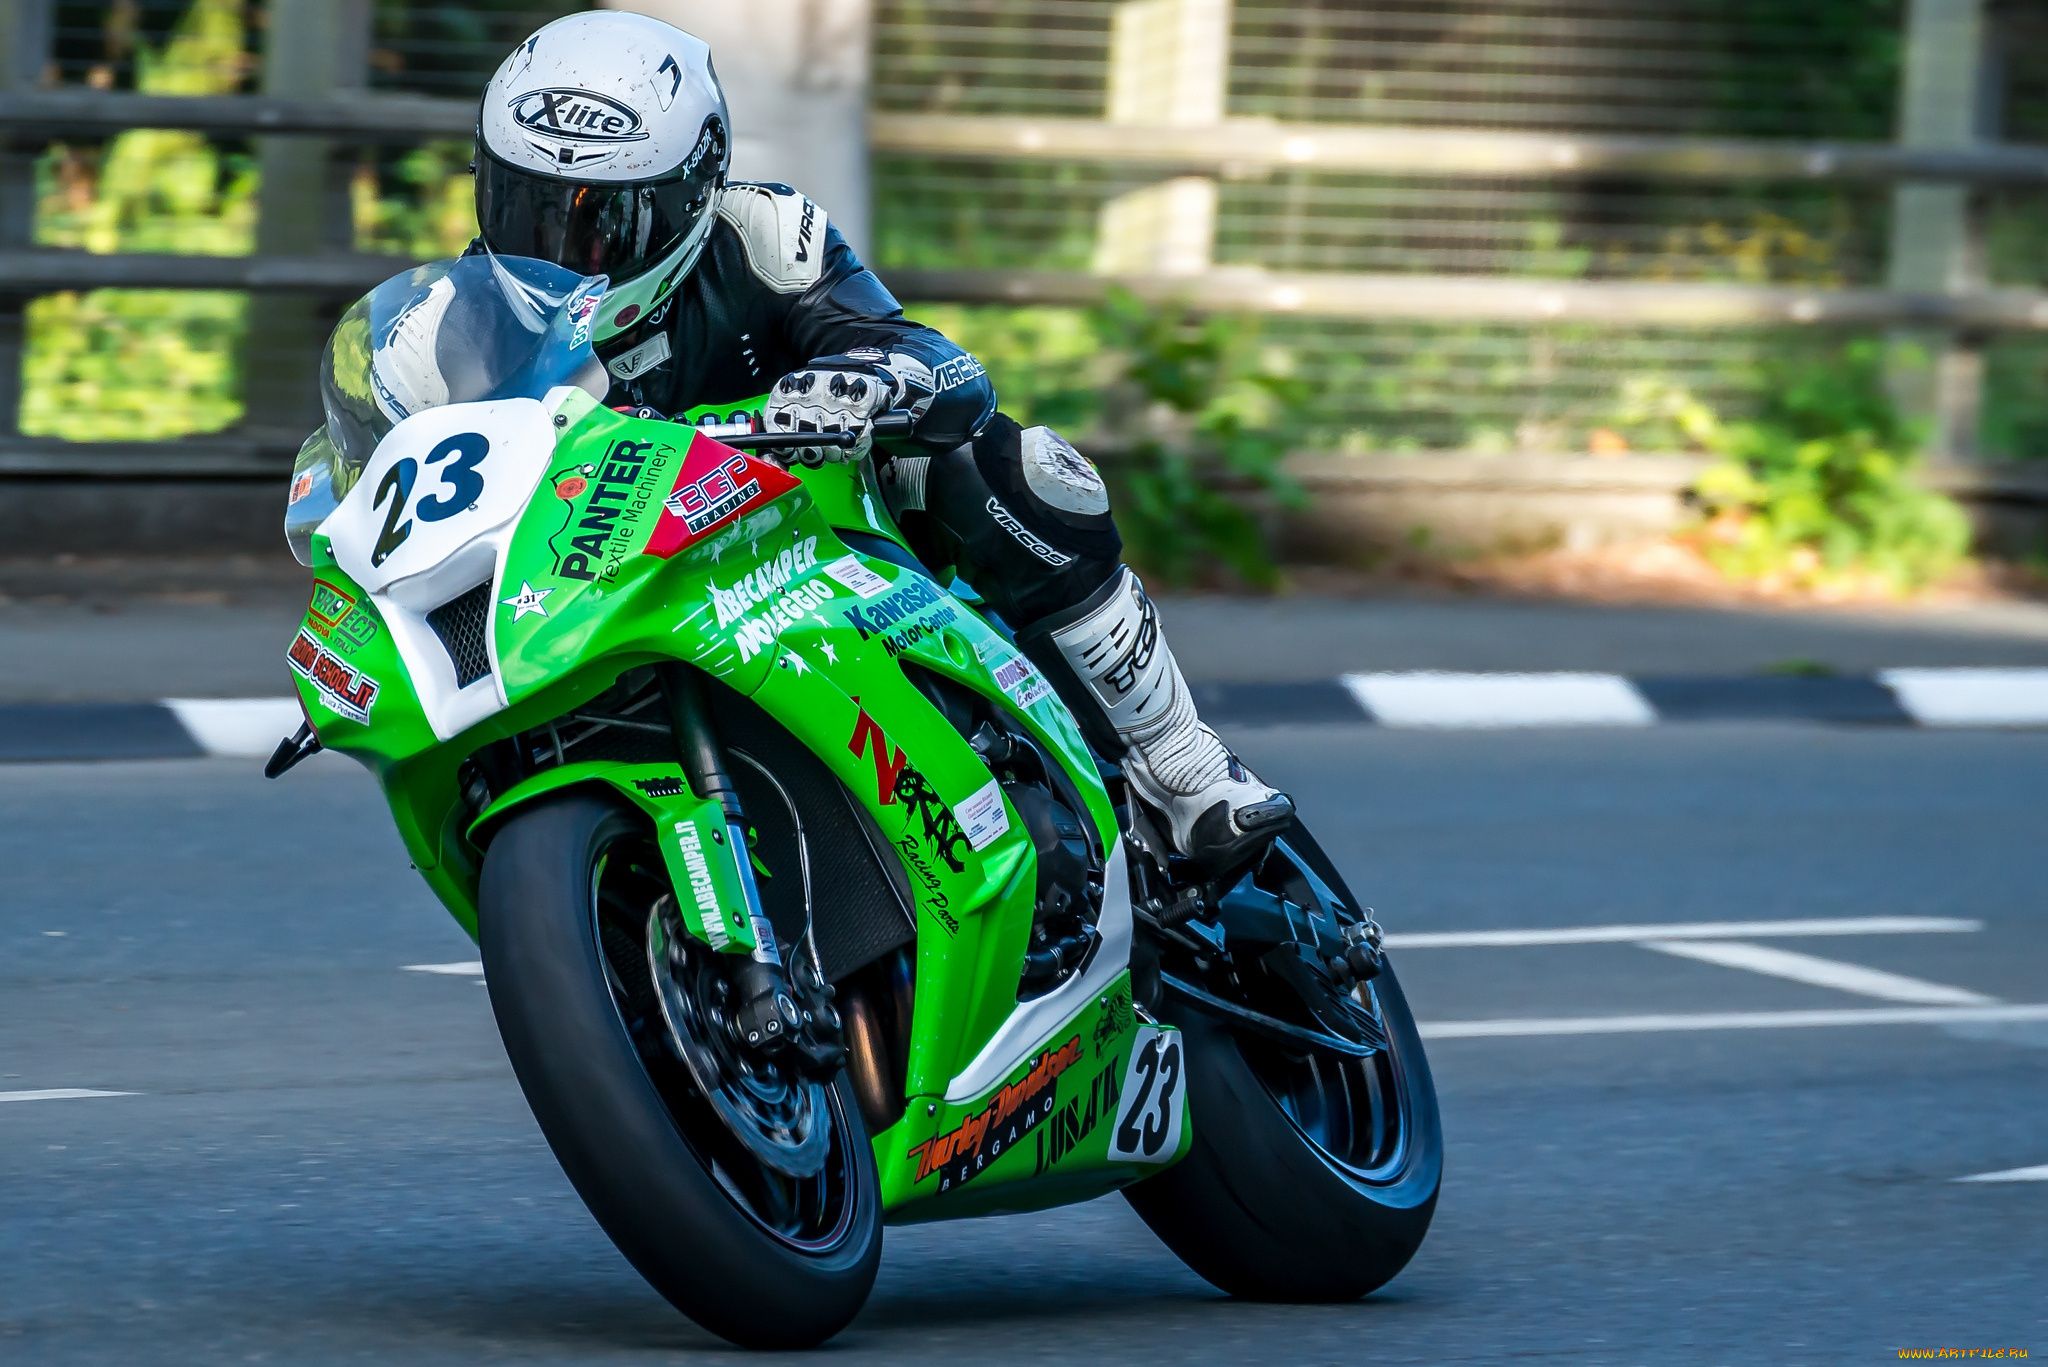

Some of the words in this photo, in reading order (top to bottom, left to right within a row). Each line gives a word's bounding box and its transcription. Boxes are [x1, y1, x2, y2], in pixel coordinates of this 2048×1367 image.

[524, 92, 625, 134] X-lite
[682, 128, 712, 181] X-802R
[371, 432, 490, 569] 23
[558, 438, 654, 583] PANTER
[597, 527, 635, 585] Textile
[626, 442, 676, 523] Machinery
[689, 485, 757, 531] TRADING
[985, 494, 1073, 567] VIRCOS
[713, 535, 819, 631] ABECAMPER
[733, 579, 835, 665] NOLEGGIO
[332, 636, 358, 656] ITALY
[881, 624, 924, 659] Motor
[918, 606, 959, 635] Center
[314, 652, 375, 709] SCHOOL.IT
[674, 819, 730, 952] WWW.ABECAMPER.IT
[895, 833, 941, 891] Racing
[926, 892, 960, 935] Parts
[908, 1035, 1084, 1184] Harley-Davidson
[941, 1096, 1053, 1191] BERGAMO
[1116, 1038, 1181, 1157] 23
